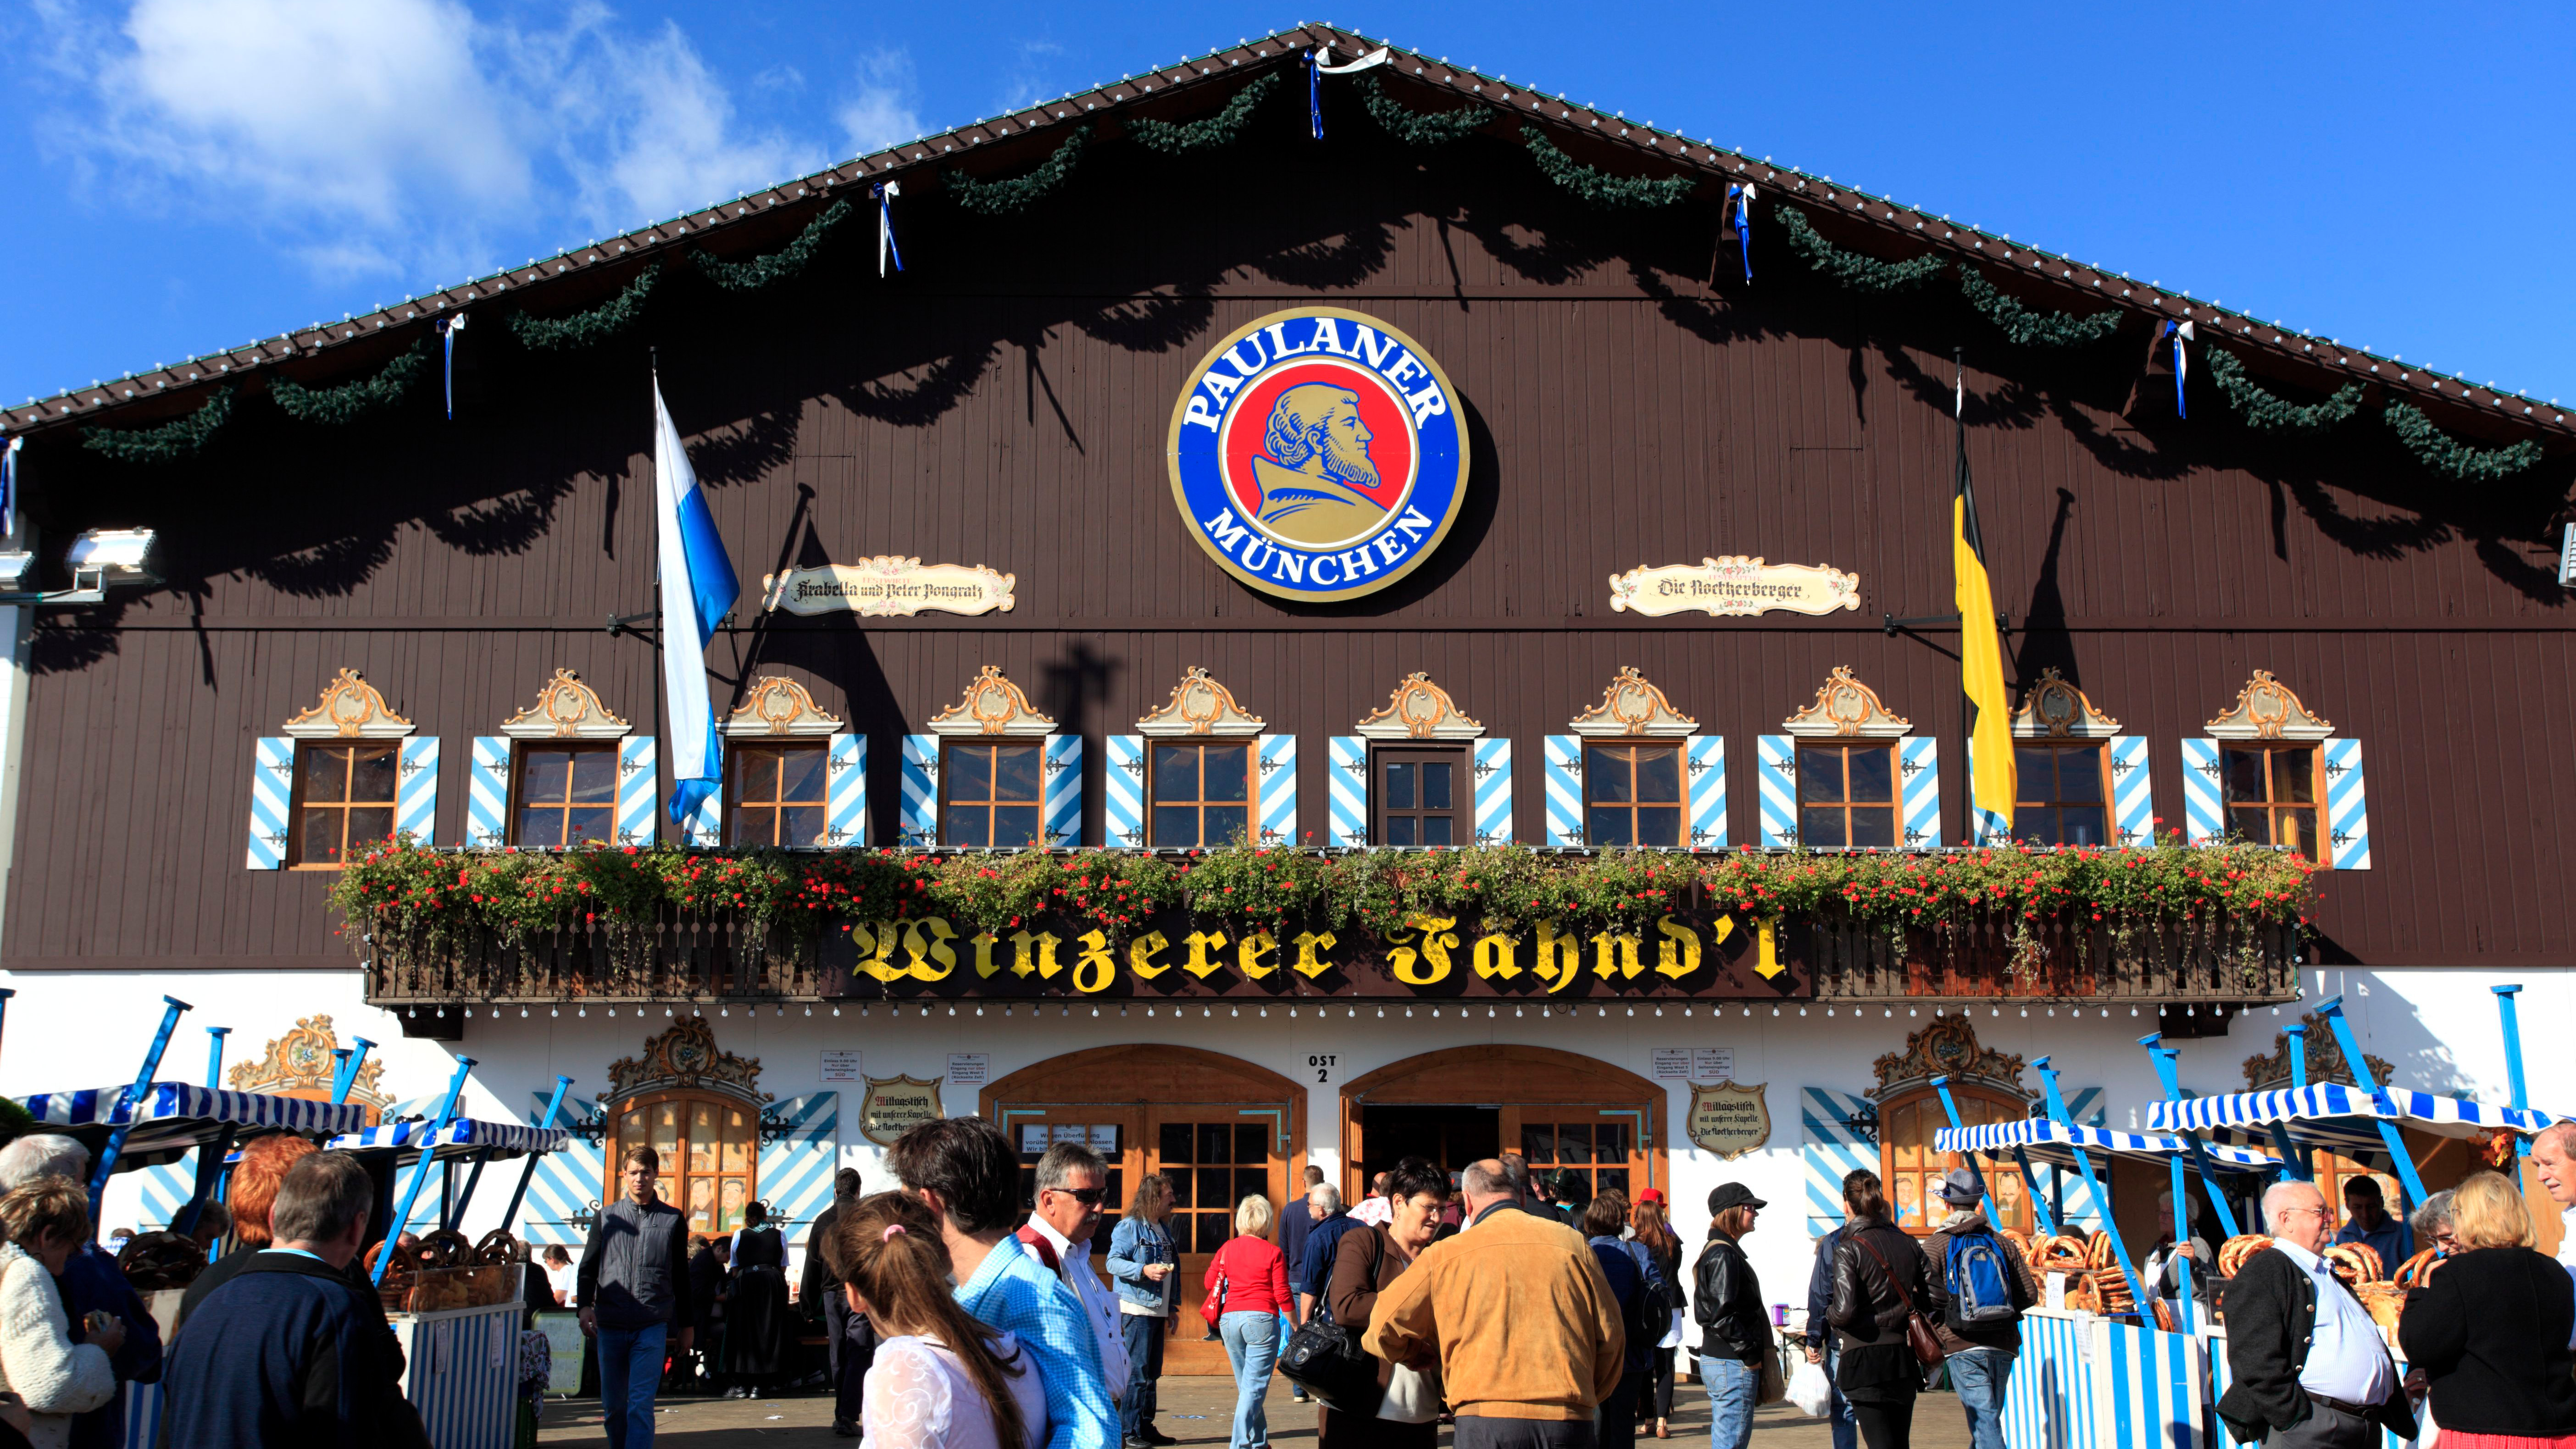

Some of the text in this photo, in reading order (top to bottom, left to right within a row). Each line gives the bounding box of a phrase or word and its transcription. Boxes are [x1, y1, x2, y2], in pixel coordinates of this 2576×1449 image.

[1183, 317, 1446, 433] PAULANER
[1204, 505, 1433, 585] MÜNCHEN
[793, 579, 858, 602] Arabella
[861, 583, 883, 597] und
[886, 583, 921, 600] Peter
[1657, 577, 1802, 602] Die Nockherberger
[852, 916, 1337, 993] Winzerer
[1309, 1055, 1336, 1066] OST
[1318, 1069, 1327, 1083] 2
[871, 1110, 881, 1118] mit
